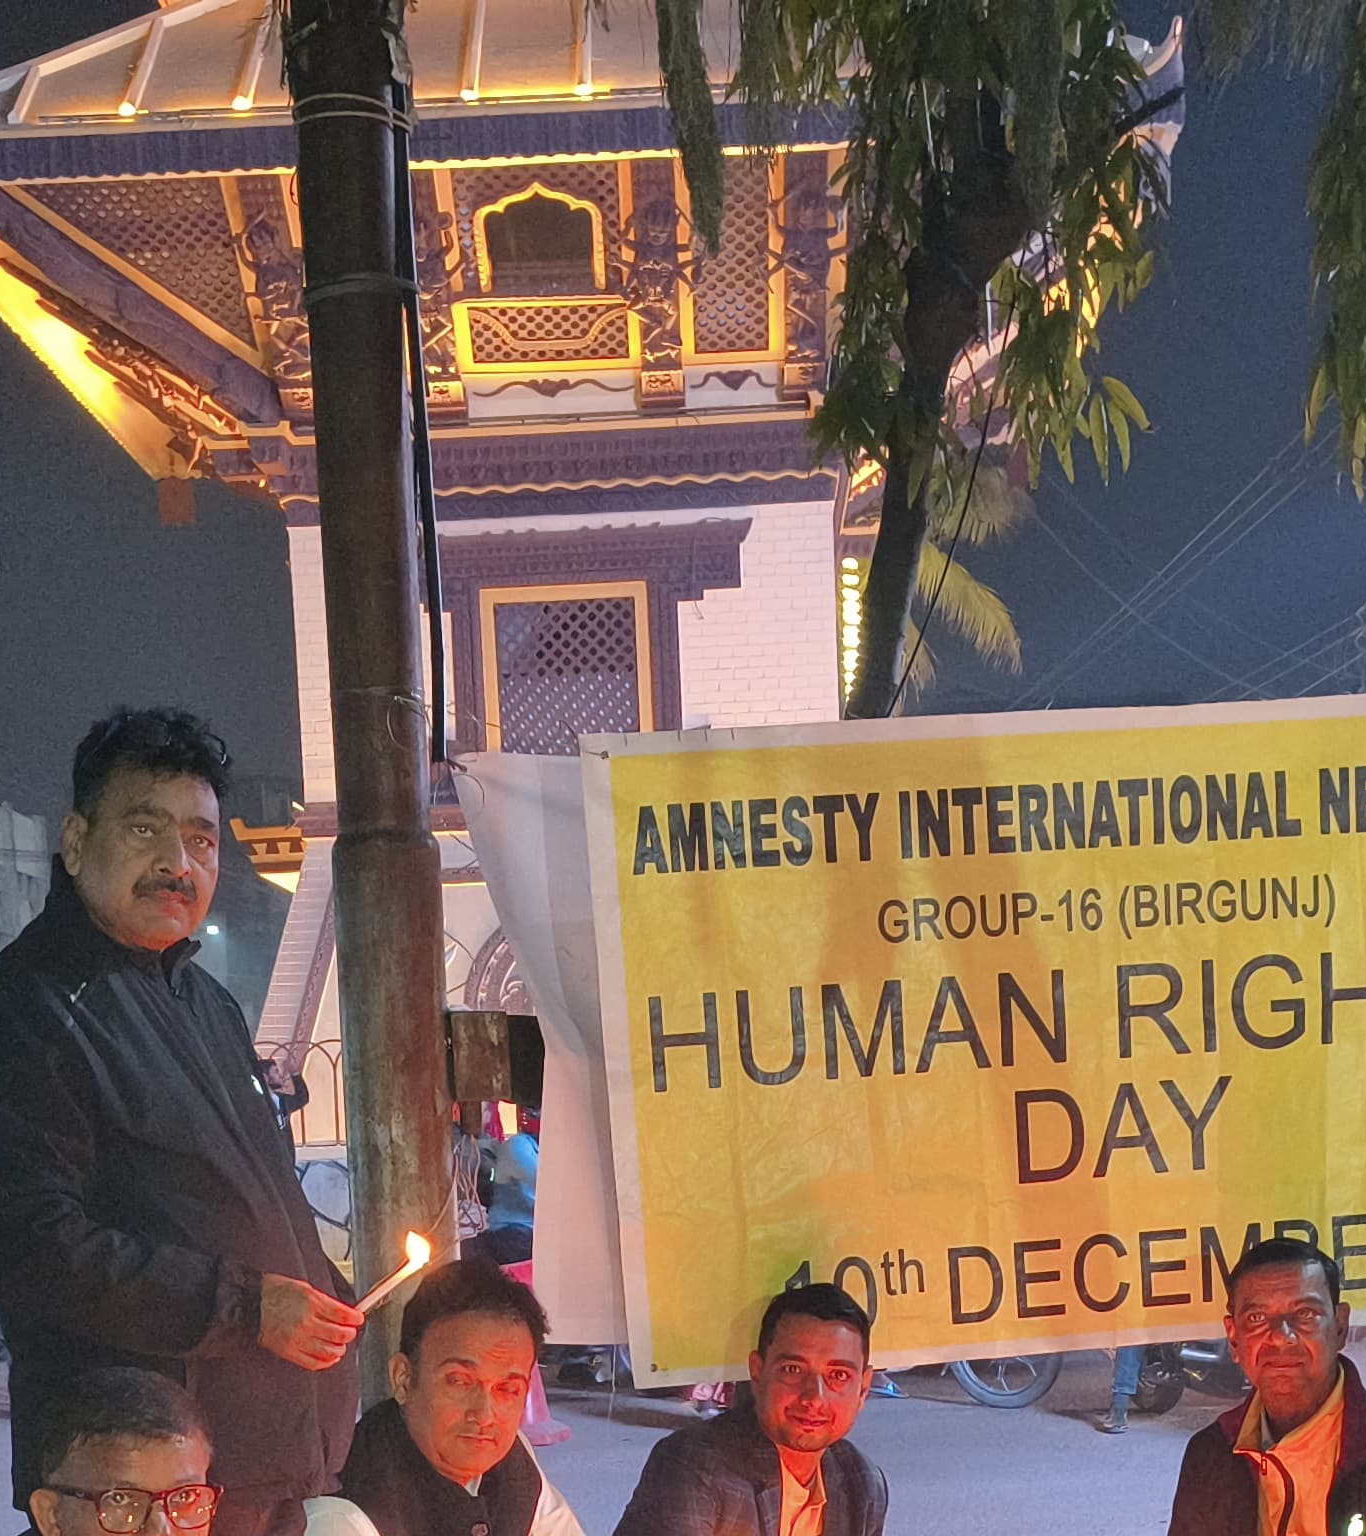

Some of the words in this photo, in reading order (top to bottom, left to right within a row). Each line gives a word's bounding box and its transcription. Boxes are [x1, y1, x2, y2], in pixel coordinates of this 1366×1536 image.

[632, 792, 880, 876] AMNESTY
[898, 770, 1302, 860] INTERNATIONAL
[877, 887, 1104, 944] GROUP-16
[1118, 873, 1336, 940] (BIRGUNJ)
[647, 968, 1068, 1093] HUMAN
[1014, 1074, 1233, 1185] DAY
